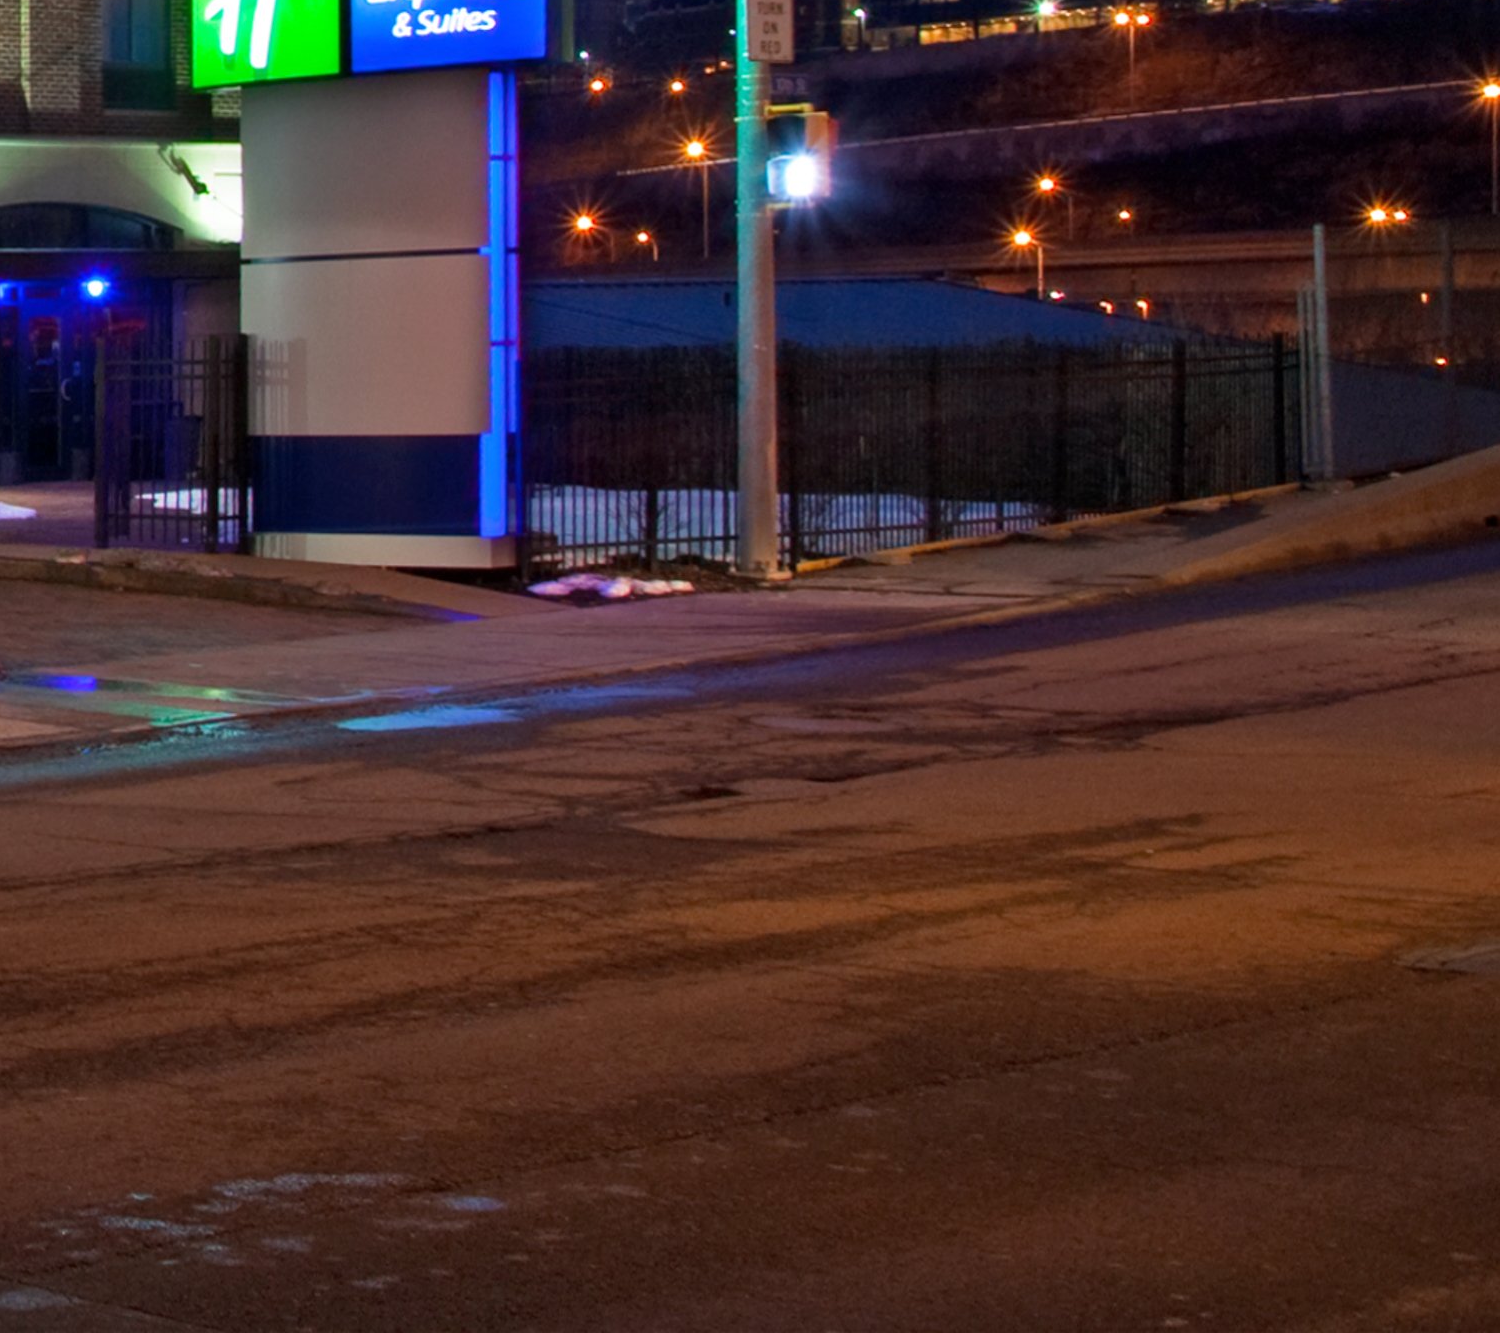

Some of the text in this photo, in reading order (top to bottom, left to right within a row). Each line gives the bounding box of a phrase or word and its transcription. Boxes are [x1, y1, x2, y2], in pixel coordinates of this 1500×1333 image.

[757, 1, 784, 15] TURN
[392, 7, 497, 38] & Suites
[762, 21, 779, 34] ON
[760, 40, 781, 54] RED
